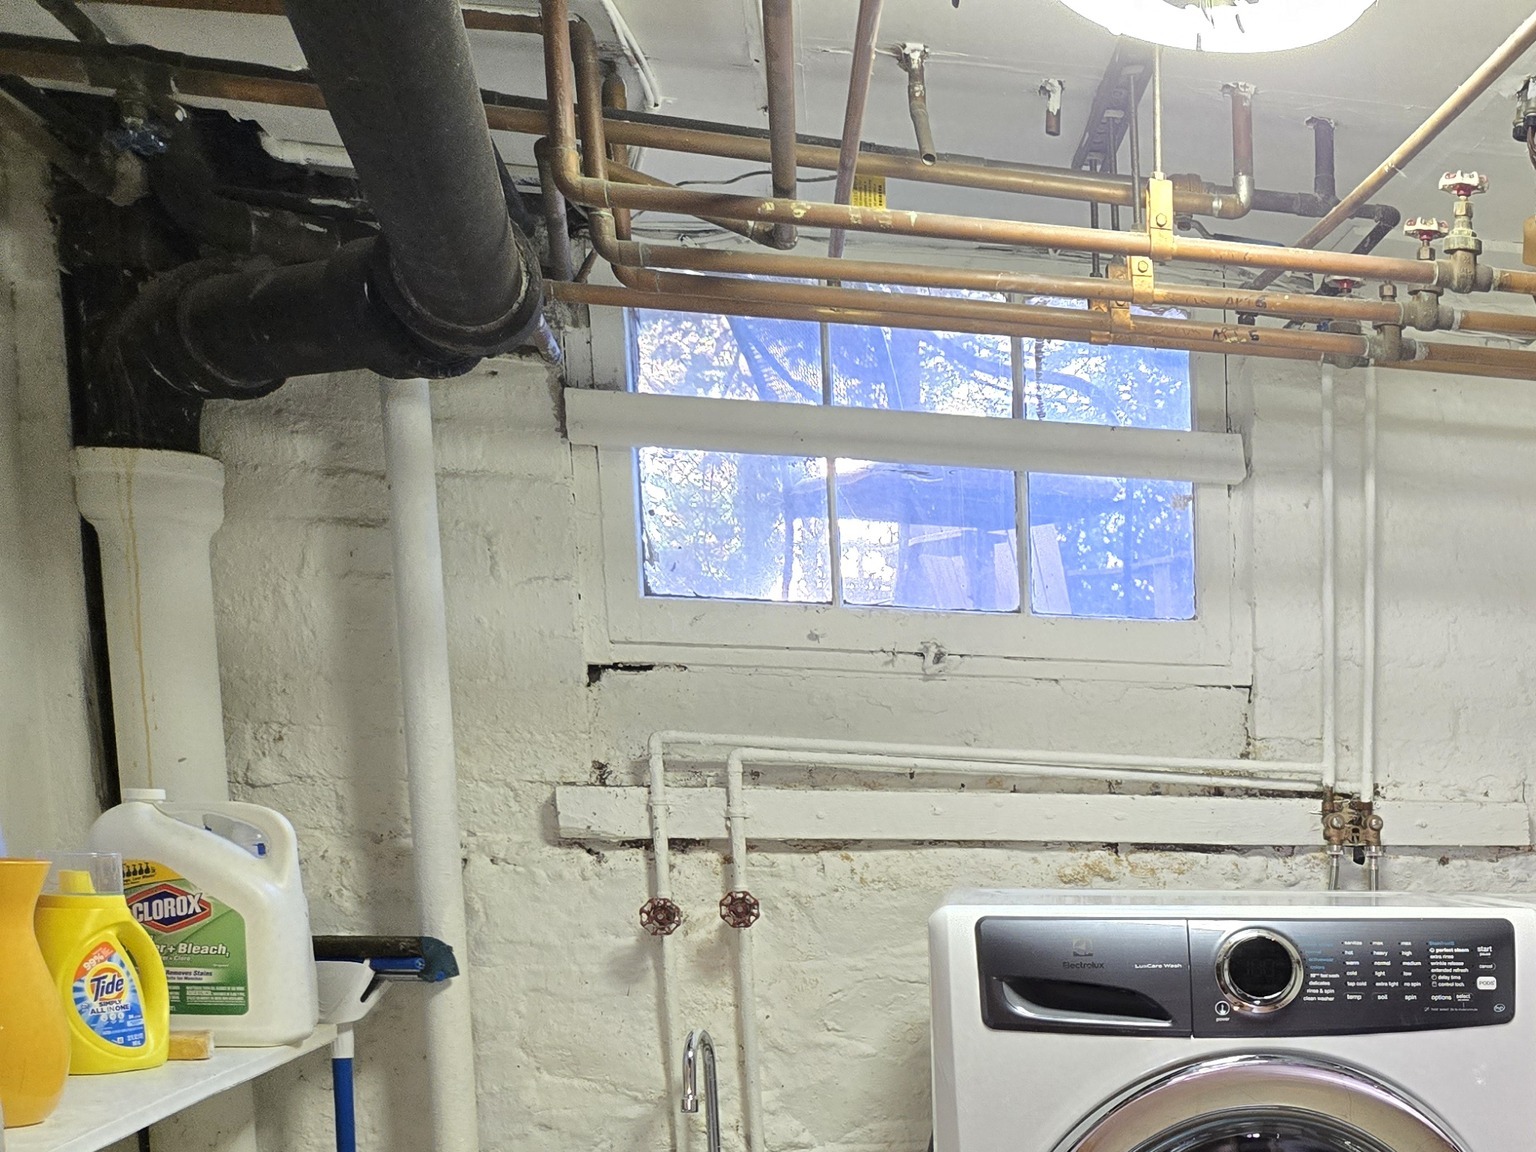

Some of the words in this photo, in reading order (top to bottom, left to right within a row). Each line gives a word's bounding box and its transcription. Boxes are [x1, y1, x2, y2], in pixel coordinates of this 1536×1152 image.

[132, 892, 204, 923] CLOROX
[177, 942, 227, 955] Bleach
[83, 953, 105, 971] 99%
[1063, 961, 1105, 969] Electrolux
[89, 974, 125, 1003] Tide
[90, 1007, 107, 1015] ALL
[115, 1002, 131, 1012] ONE
[98, 999, 122, 1008] SIMPLY
